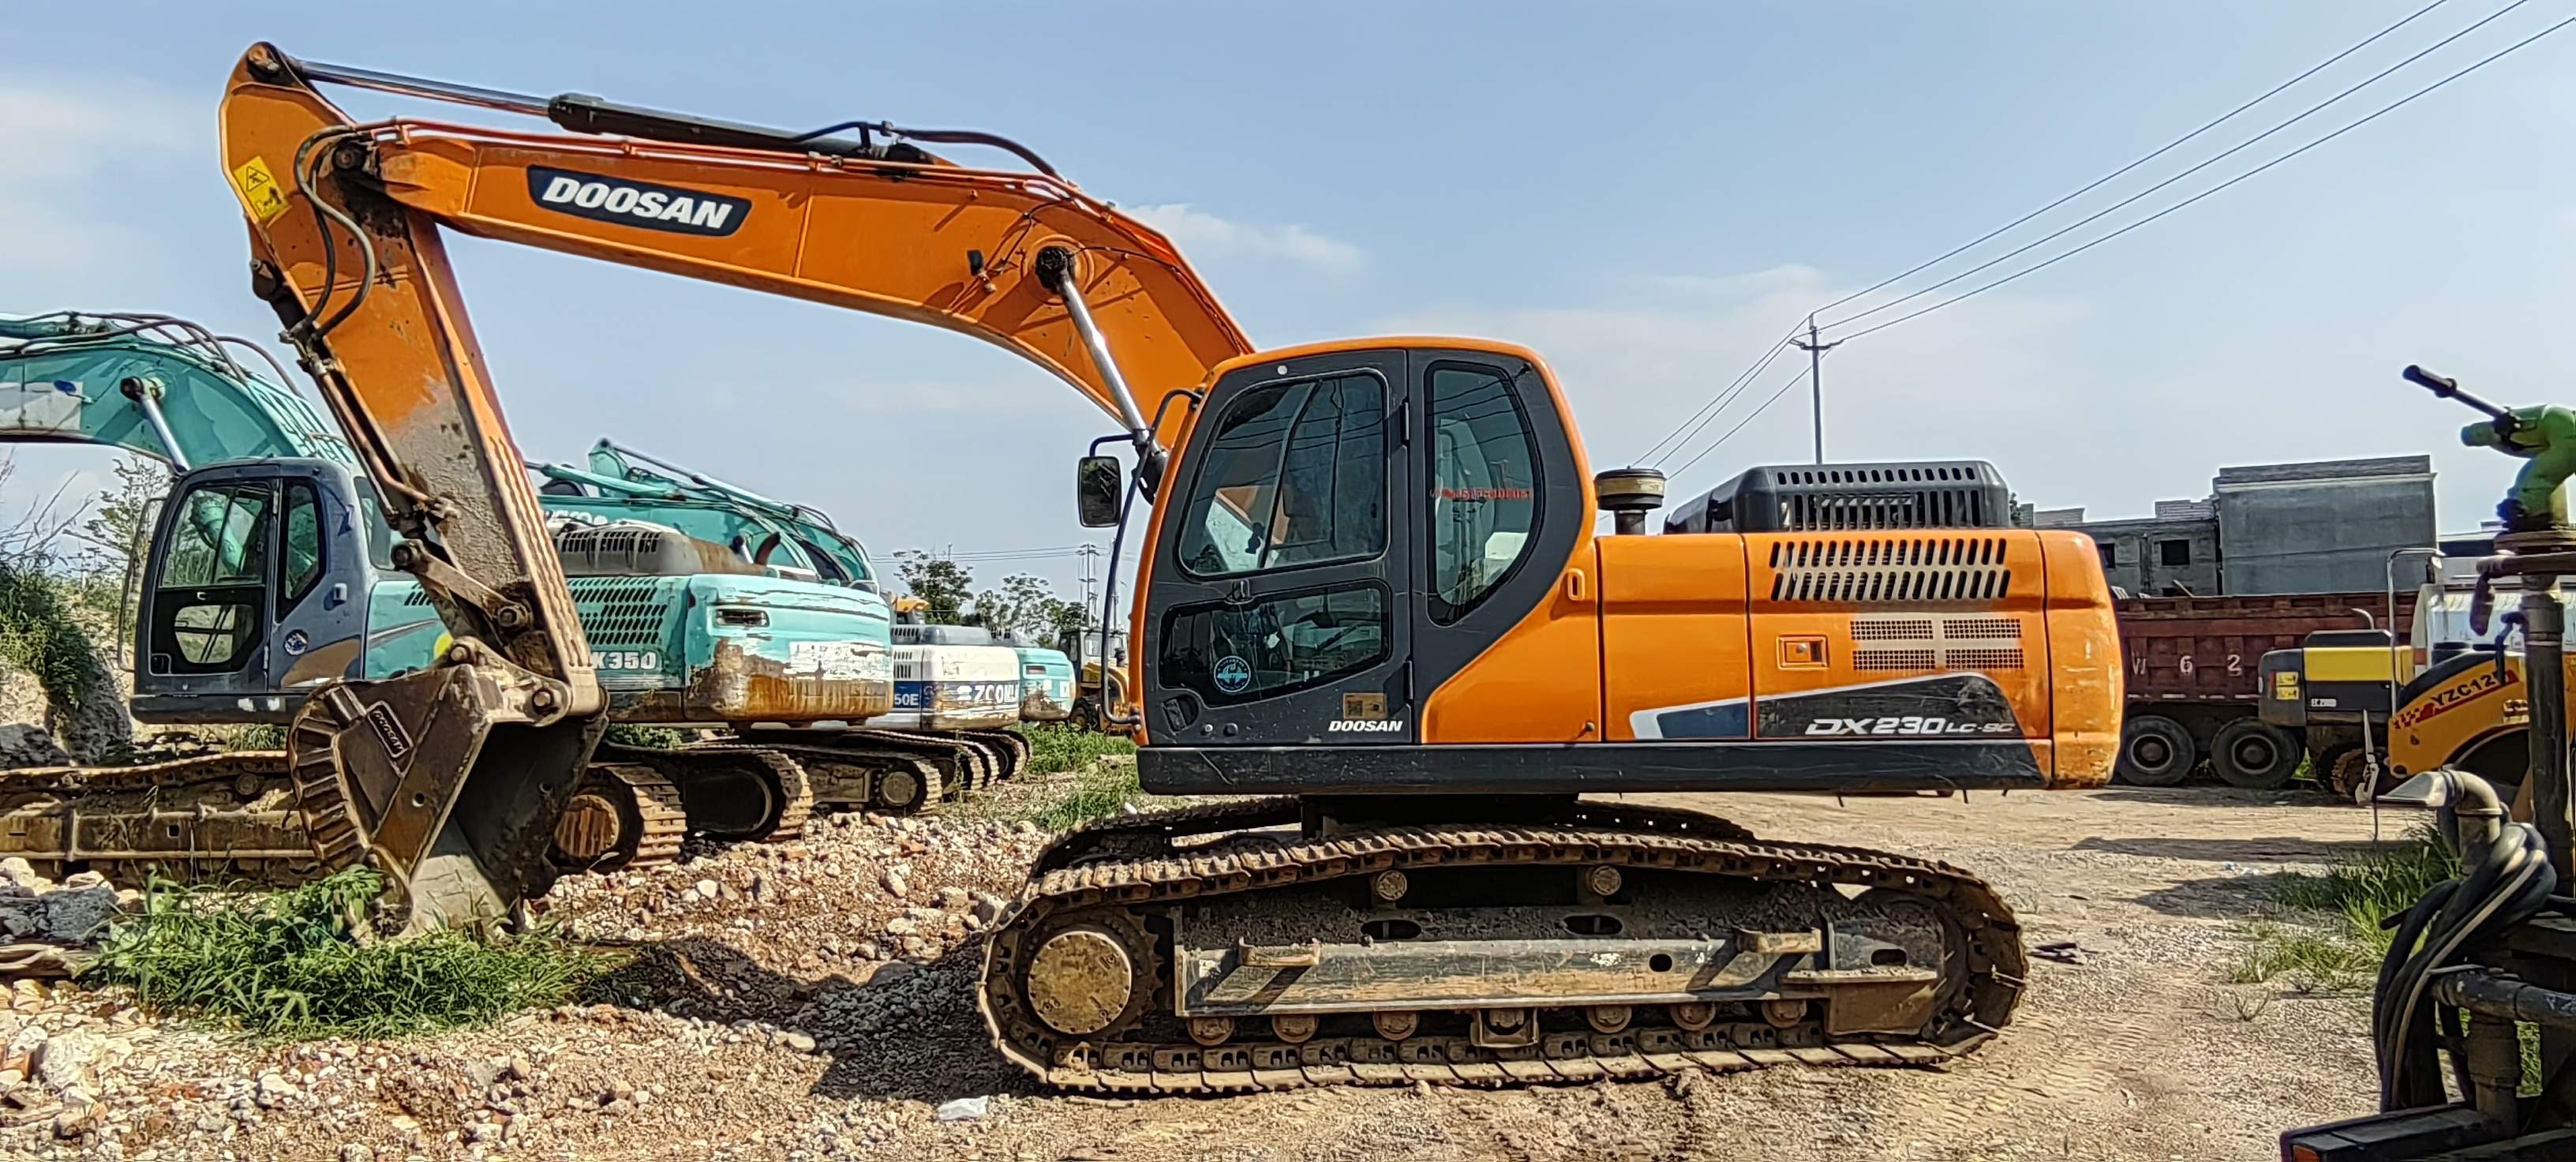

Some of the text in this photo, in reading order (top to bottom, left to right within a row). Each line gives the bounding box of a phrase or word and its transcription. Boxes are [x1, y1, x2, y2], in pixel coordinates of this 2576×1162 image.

[541, 176, 732, 229] DOOSAN
[2180, 655, 2192, 674] 6
[2227, 654, 2241, 677] 2
[2431, 670, 2499, 706] YZC12
[1328, 721, 1402, 732] DOOSAN
